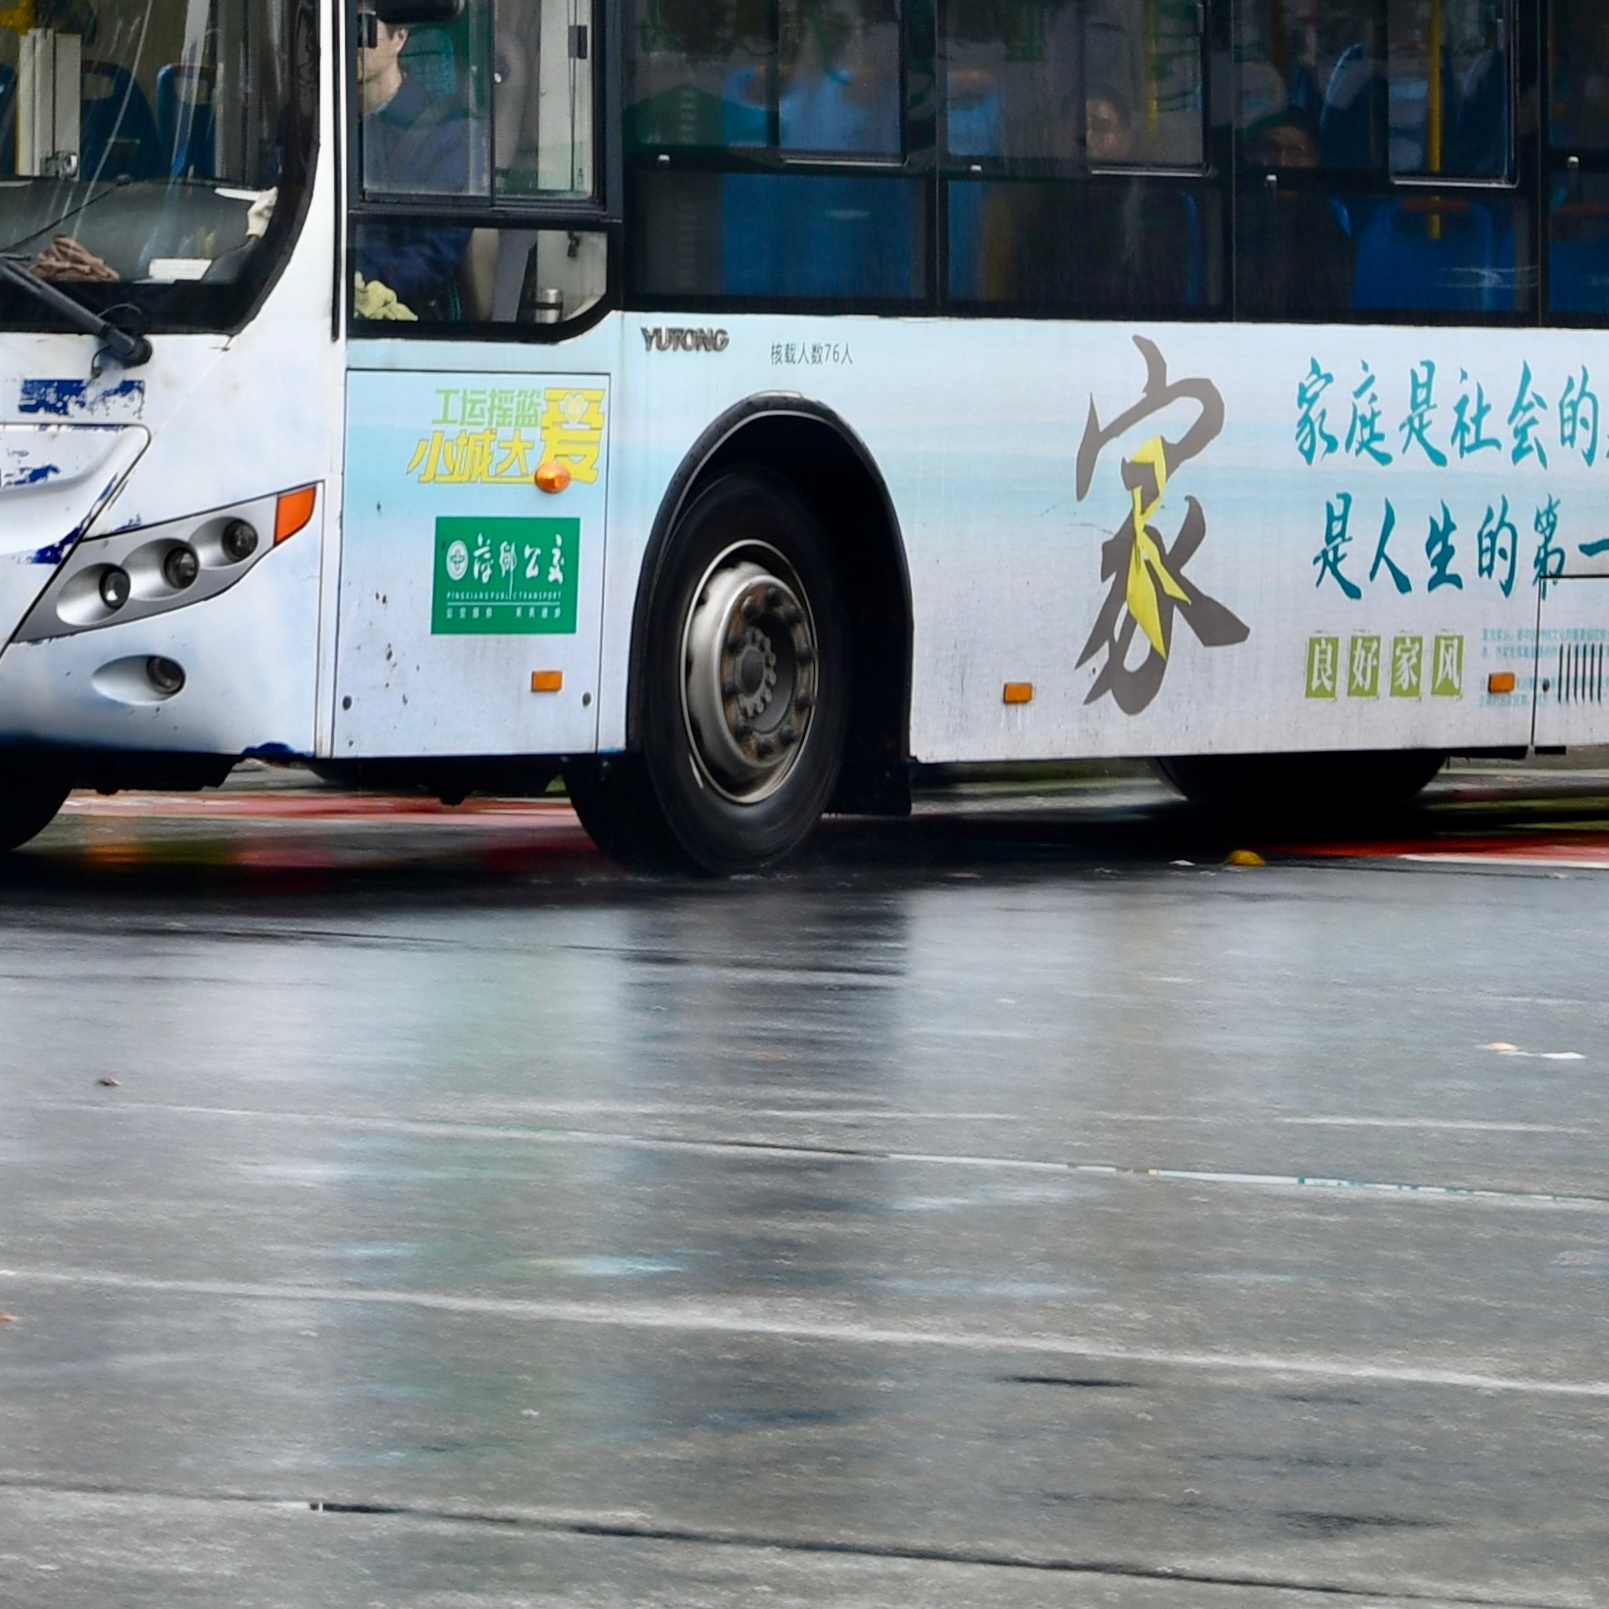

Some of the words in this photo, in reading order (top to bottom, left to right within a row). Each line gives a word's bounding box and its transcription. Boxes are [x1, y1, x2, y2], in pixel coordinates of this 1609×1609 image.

[641, 327, 730, 352] YUTONG
[771, 342, 853, 366] 核载人数76人
[432, 389, 542, 428] 工运摇篮
[406, 388, 606, 485] 小城大爱
[1304, 637, 1460, 692] 良好家风
